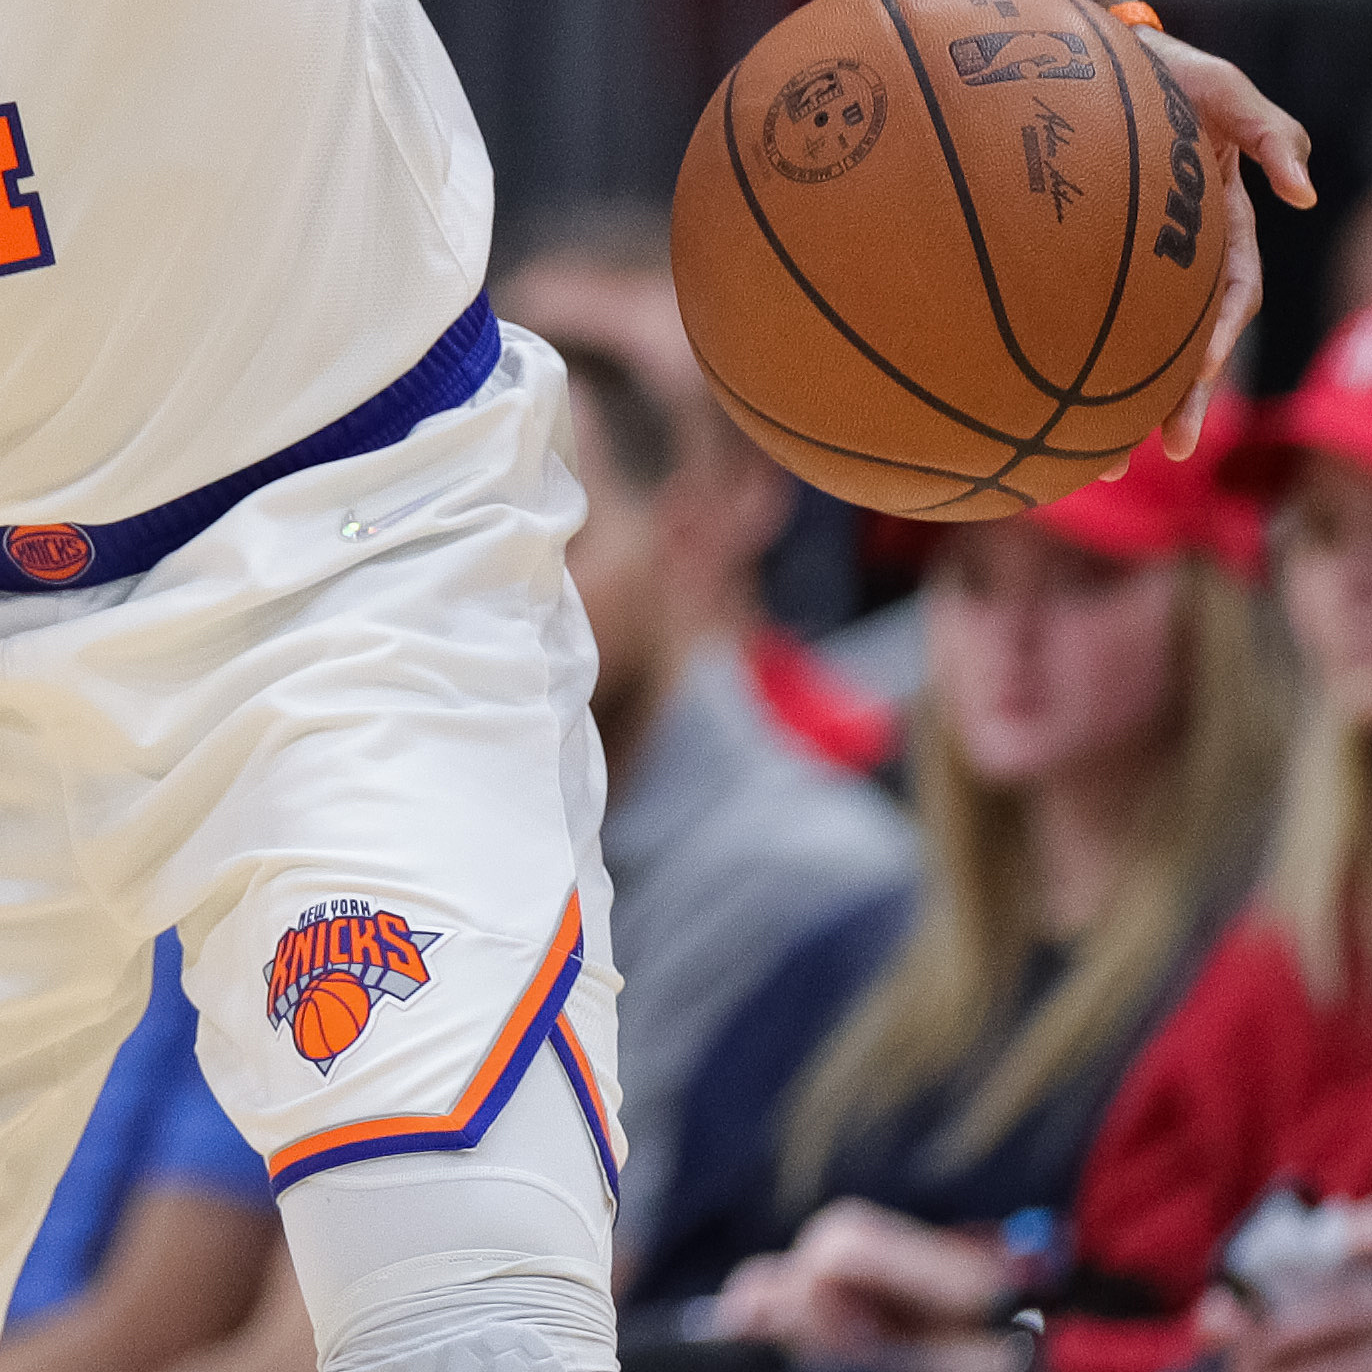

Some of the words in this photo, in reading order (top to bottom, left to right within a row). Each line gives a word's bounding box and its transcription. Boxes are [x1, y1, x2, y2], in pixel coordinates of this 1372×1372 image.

[297, 900, 327, 930] NEW
[330, 898, 372, 919] YORK
[266, 909, 432, 1014] KNICKS
